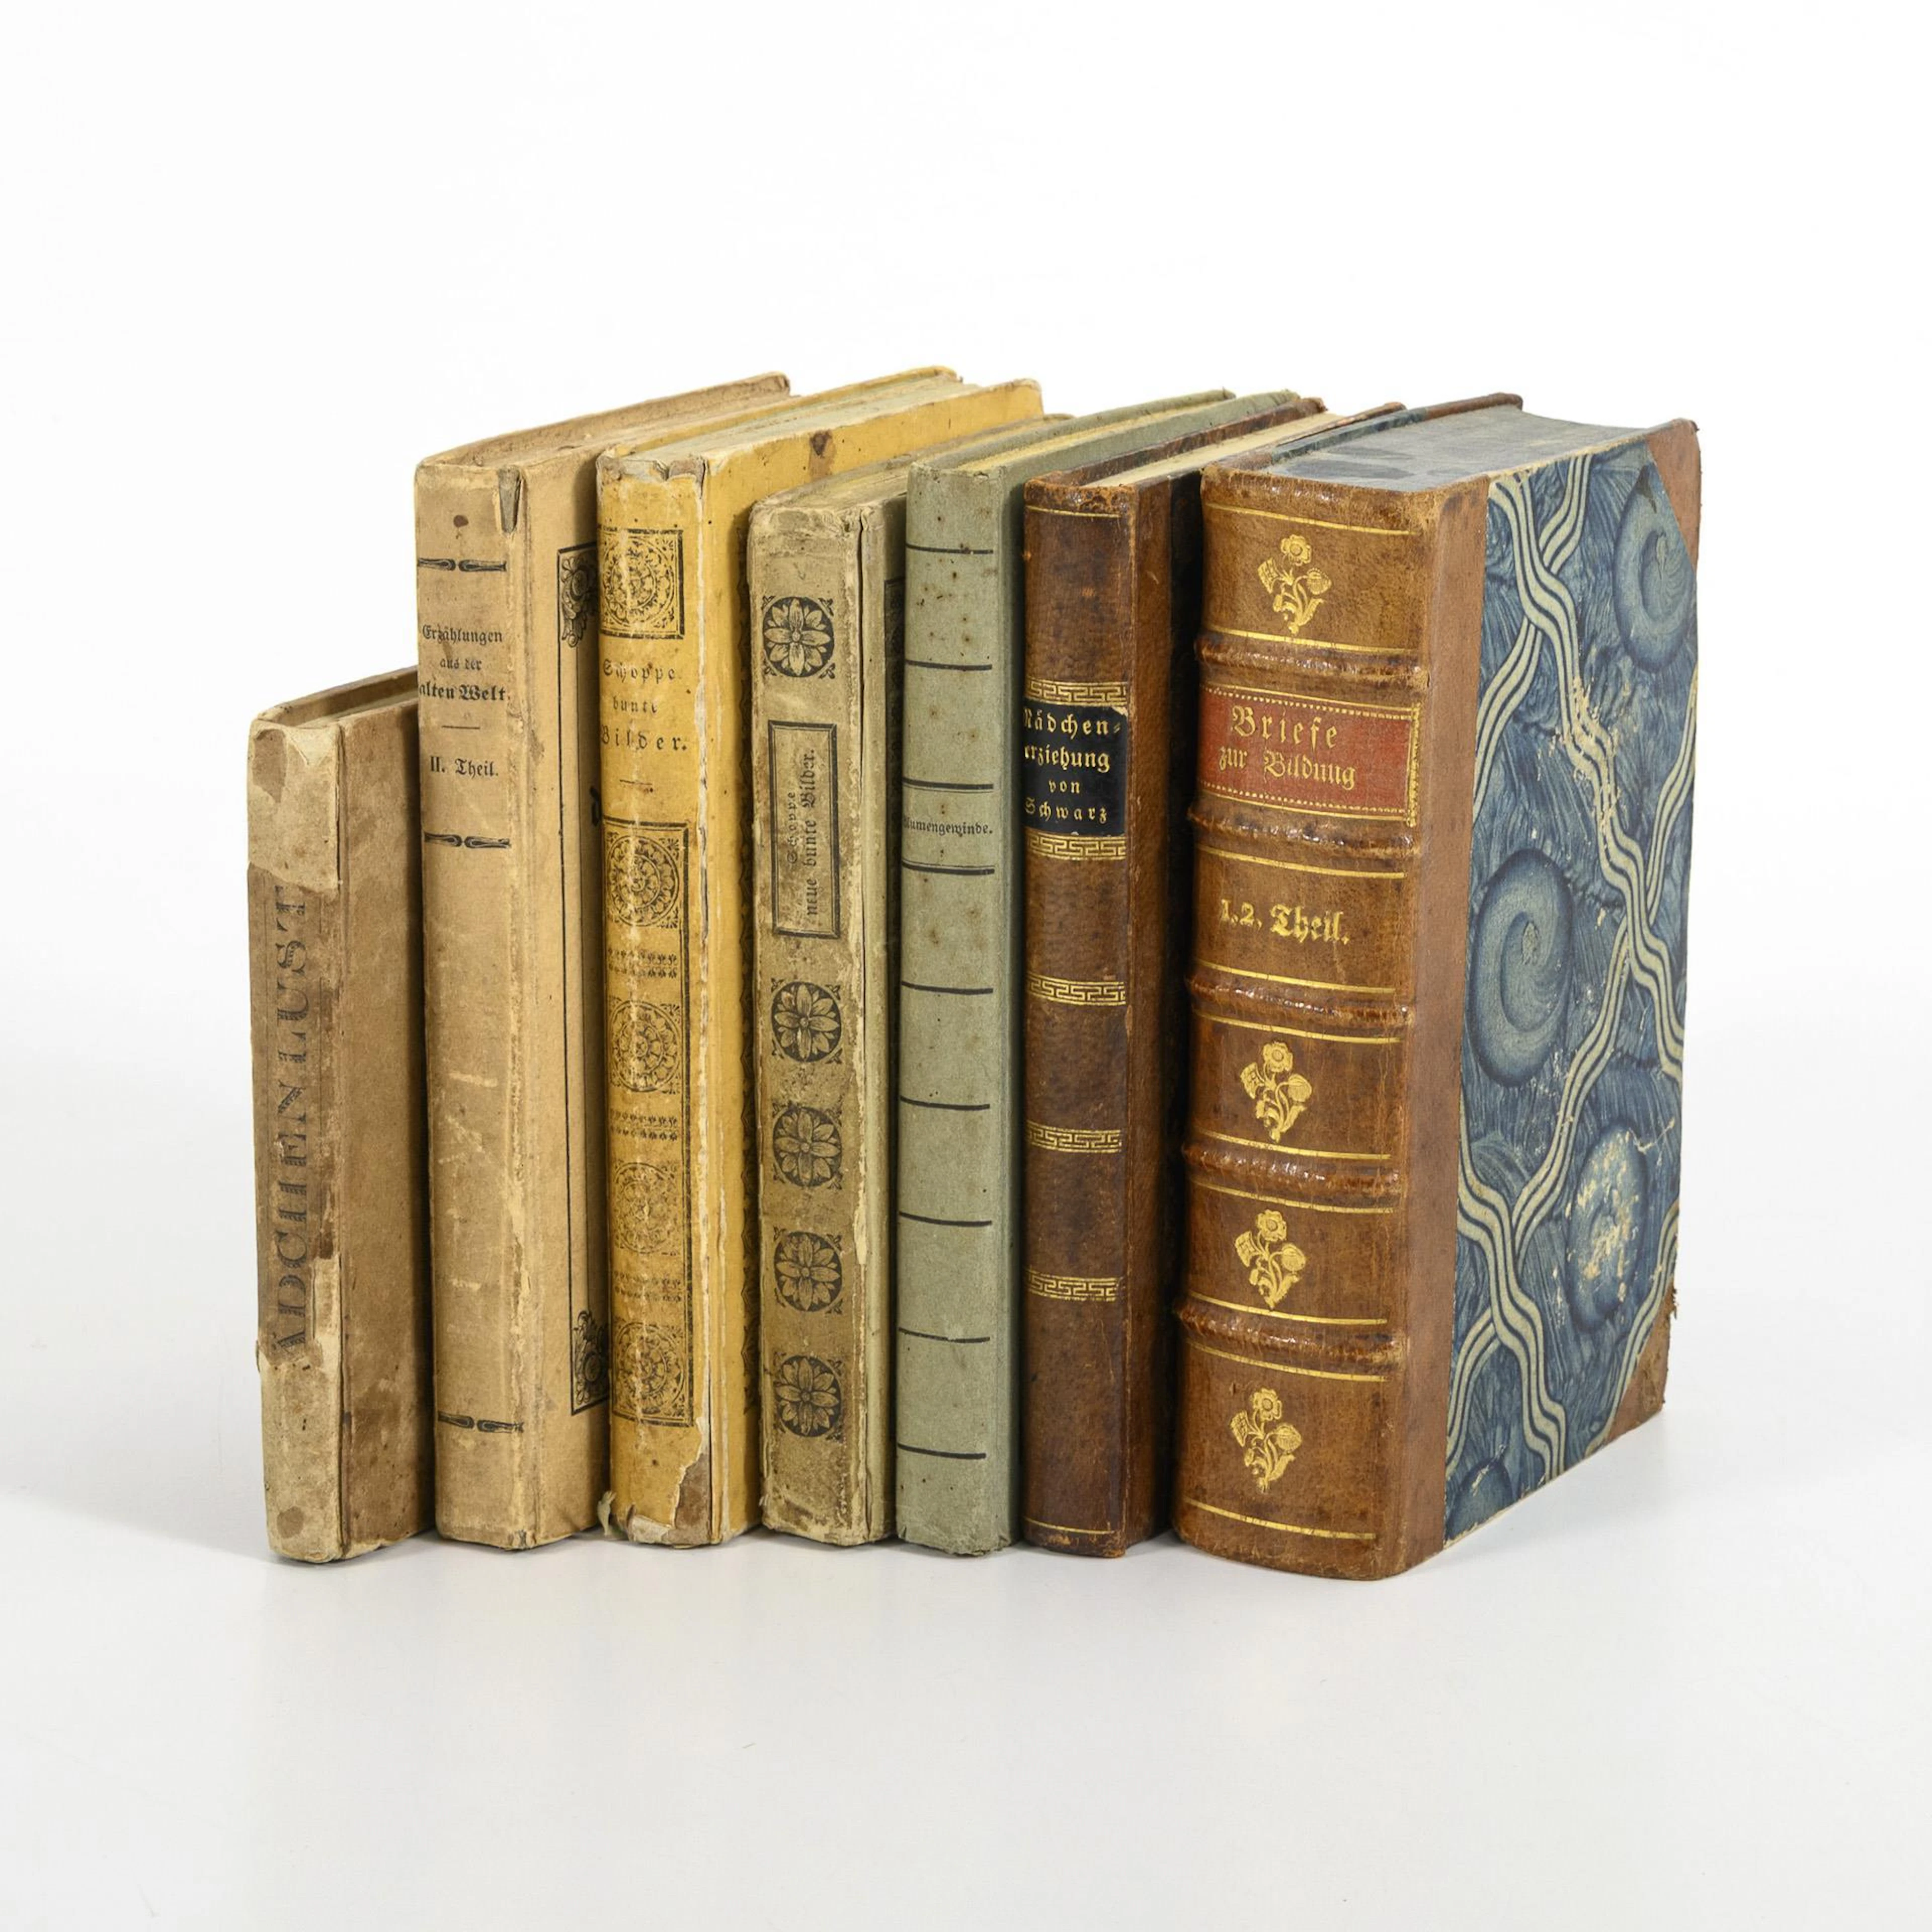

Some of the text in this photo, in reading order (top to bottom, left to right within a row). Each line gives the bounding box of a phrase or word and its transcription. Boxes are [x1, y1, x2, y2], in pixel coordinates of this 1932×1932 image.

[422, 623, 503, 644] Erzählungen
[440, 658, 482, 671] aus der
[613, 696, 657, 713] bunte
[1232, 705, 1338, 753] Briefe
[455, 758, 499, 779] Theil.
[1024, 744, 1110, 773] erziehung
[1219, 746, 1356, 791] zur Bildung
[1049, 780, 1080, 794] von
[1025, 797, 1107, 824] Schwarz
[786, 792, 799, 865] Schoppe
[800, 749, 818, 916] neue bunte Bilder.
[1269, 904, 1350, 945] Theil.
